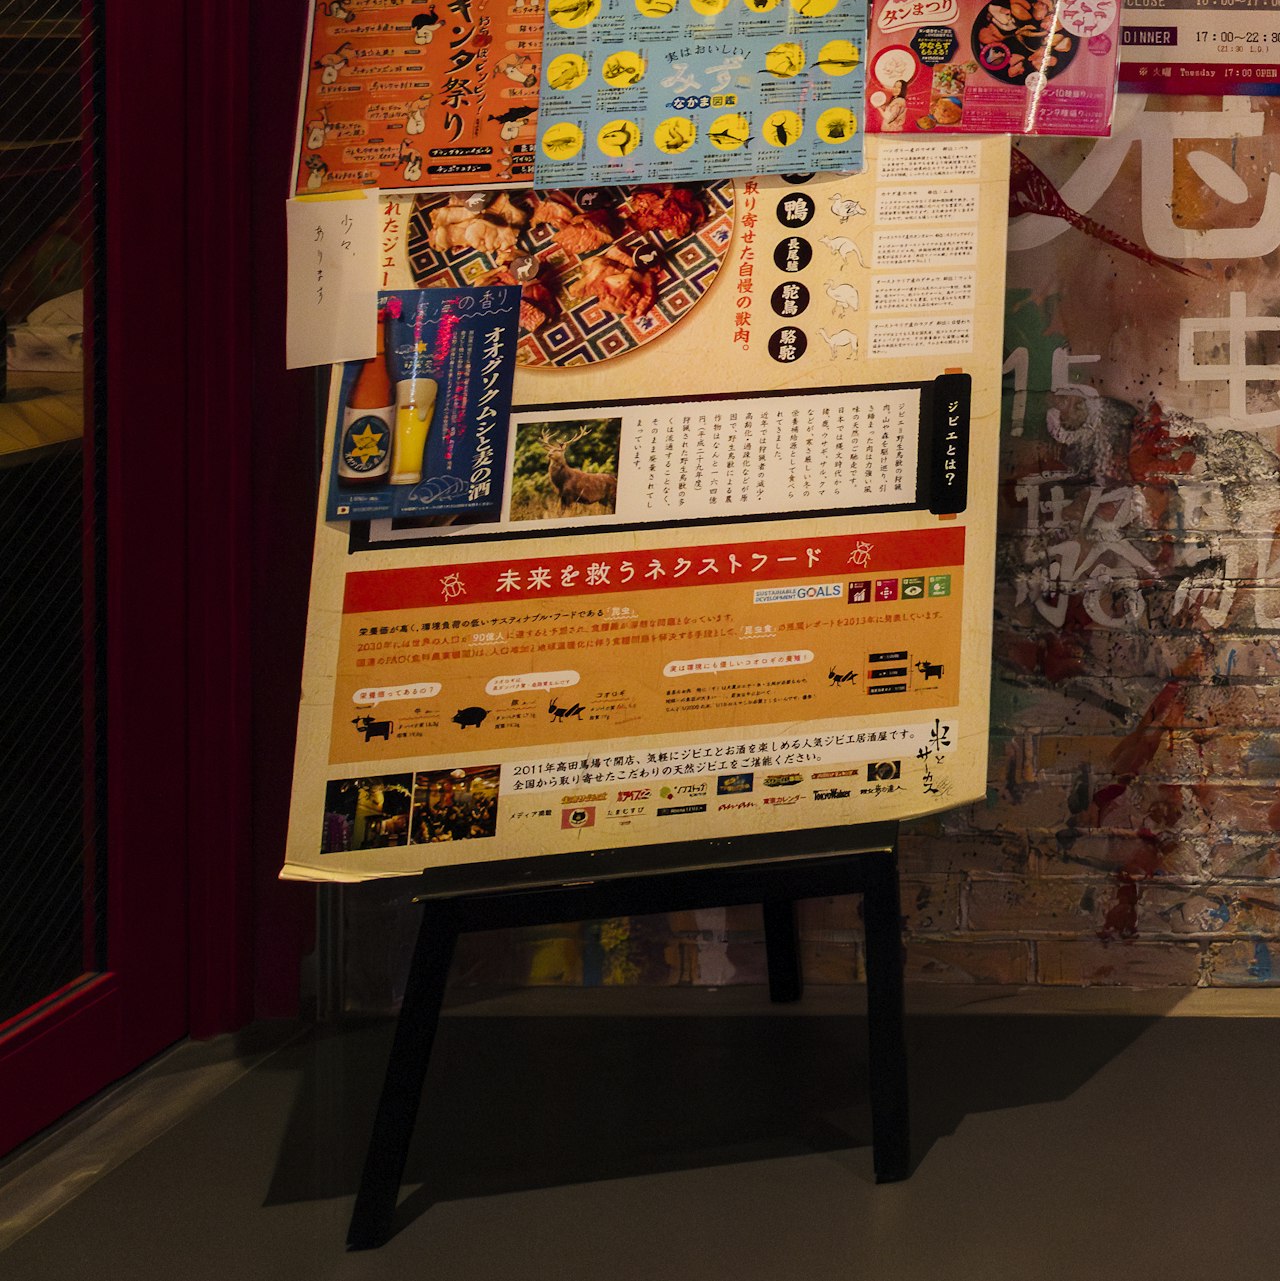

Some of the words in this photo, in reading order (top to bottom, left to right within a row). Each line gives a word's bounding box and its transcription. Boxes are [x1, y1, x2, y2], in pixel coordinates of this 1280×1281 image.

[918, 40, 950, 50] かならず
[1123, 31, 1171, 44] DINNER
[1153, 67, 1172, 78] 火曜
[1180, 68, 1216, 78] Tuesday
[1224, 68, 1253, 78] 17:00
[1255, 68, 1278, 78] OPEN
[784, 198, 809, 222] 鴨
[314, 224, 325, 305] あります
[782, 284, 800, 316] 駝鳥
[778, 329, 797, 361] 駱駝
[467, 325, 506, 501] オオグソクムシと麦の酒
[633, 419, 643, 470] まっています。
[773, 411, 784, 462] れてきました。
[833, 406, 845, 495] 日本では縄文時代から
[944, 401, 959, 486] ジビエとは?
[496, 547, 822, 593] 未来を救うネクストフード
[797, 584, 841, 599] GOALS
